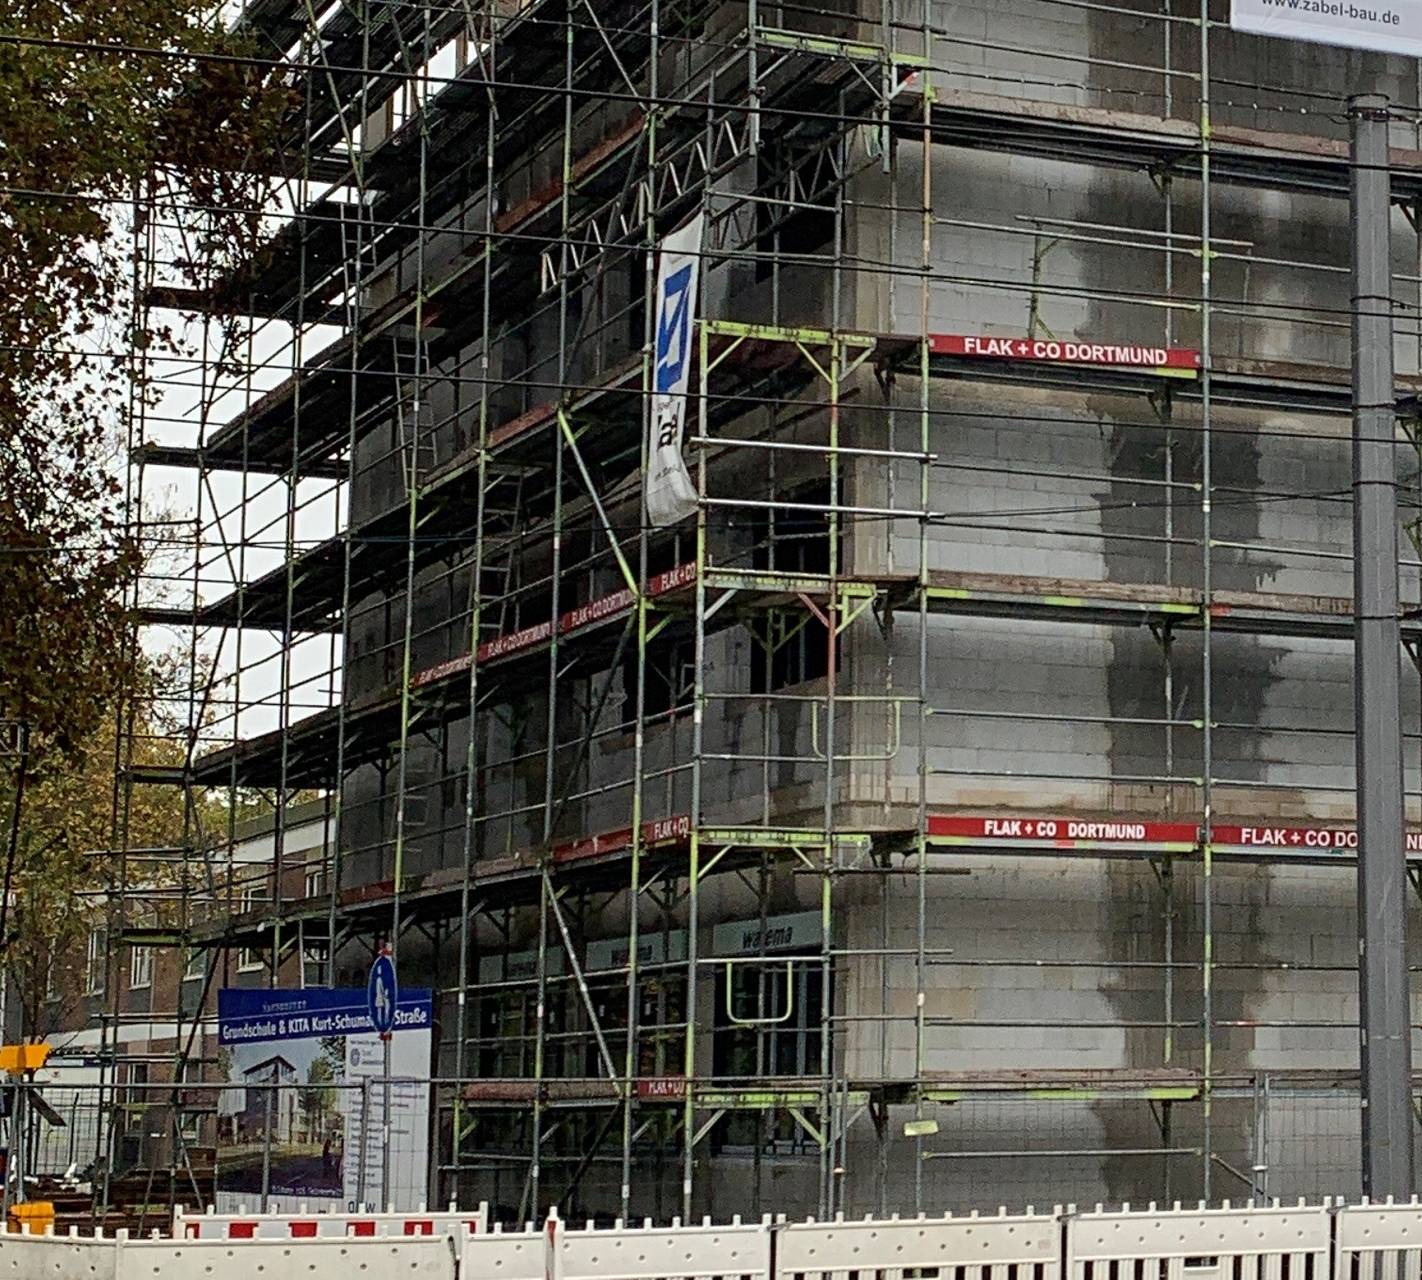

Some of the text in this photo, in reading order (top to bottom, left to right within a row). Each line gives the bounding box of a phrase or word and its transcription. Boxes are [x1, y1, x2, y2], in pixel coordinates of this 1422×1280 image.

[965, 337, 1167, 365] FLAK + CO DORTMUND
[661, 569, 680, 592] FLAK
[685, 562, 696, 581] CO
[655, 819, 673, 839] FLAK
[984, 821, 1146, 840] FLAK + CO DORTMUND
[1241, 828, 1287, 845] FLAK
[1290, 833, 1301, 844] +
[1305, 831, 1332, 847] CO
[742, 926, 793, 950] waema
[222, 1021, 277, 1040] Grundschule
[288, 1018, 310, 1034] KITA
